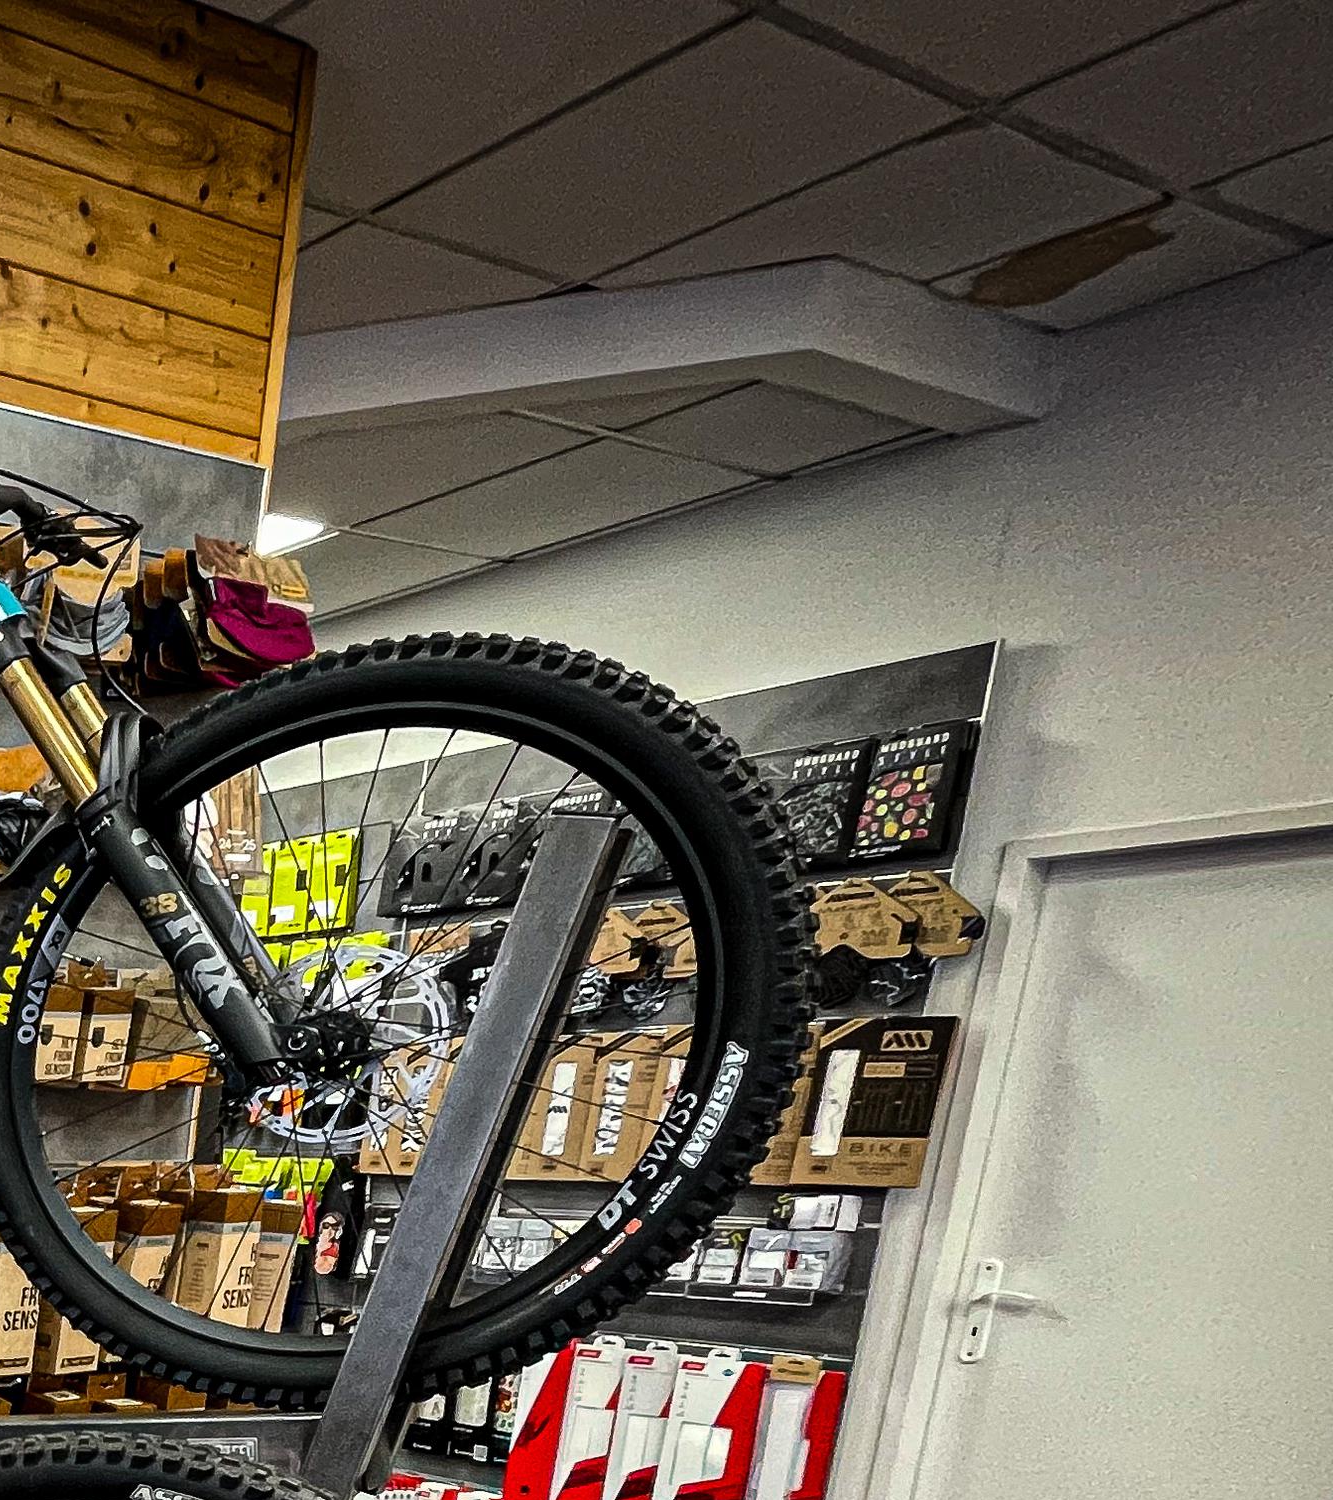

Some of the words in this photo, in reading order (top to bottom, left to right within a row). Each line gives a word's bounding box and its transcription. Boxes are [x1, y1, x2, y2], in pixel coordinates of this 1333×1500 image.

[164, 914, 247, 1010] FOX
[17, 978, 49, 1045] 1700
[678, 1041, 749, 1168] ASSEGAI
[597, 1180, 637, 1230] DT
[639, 1092, 699, 1179] SWISS
[2, 1310, 38, 1332] SENS
[222, 1288, 252, 1310] SENS
